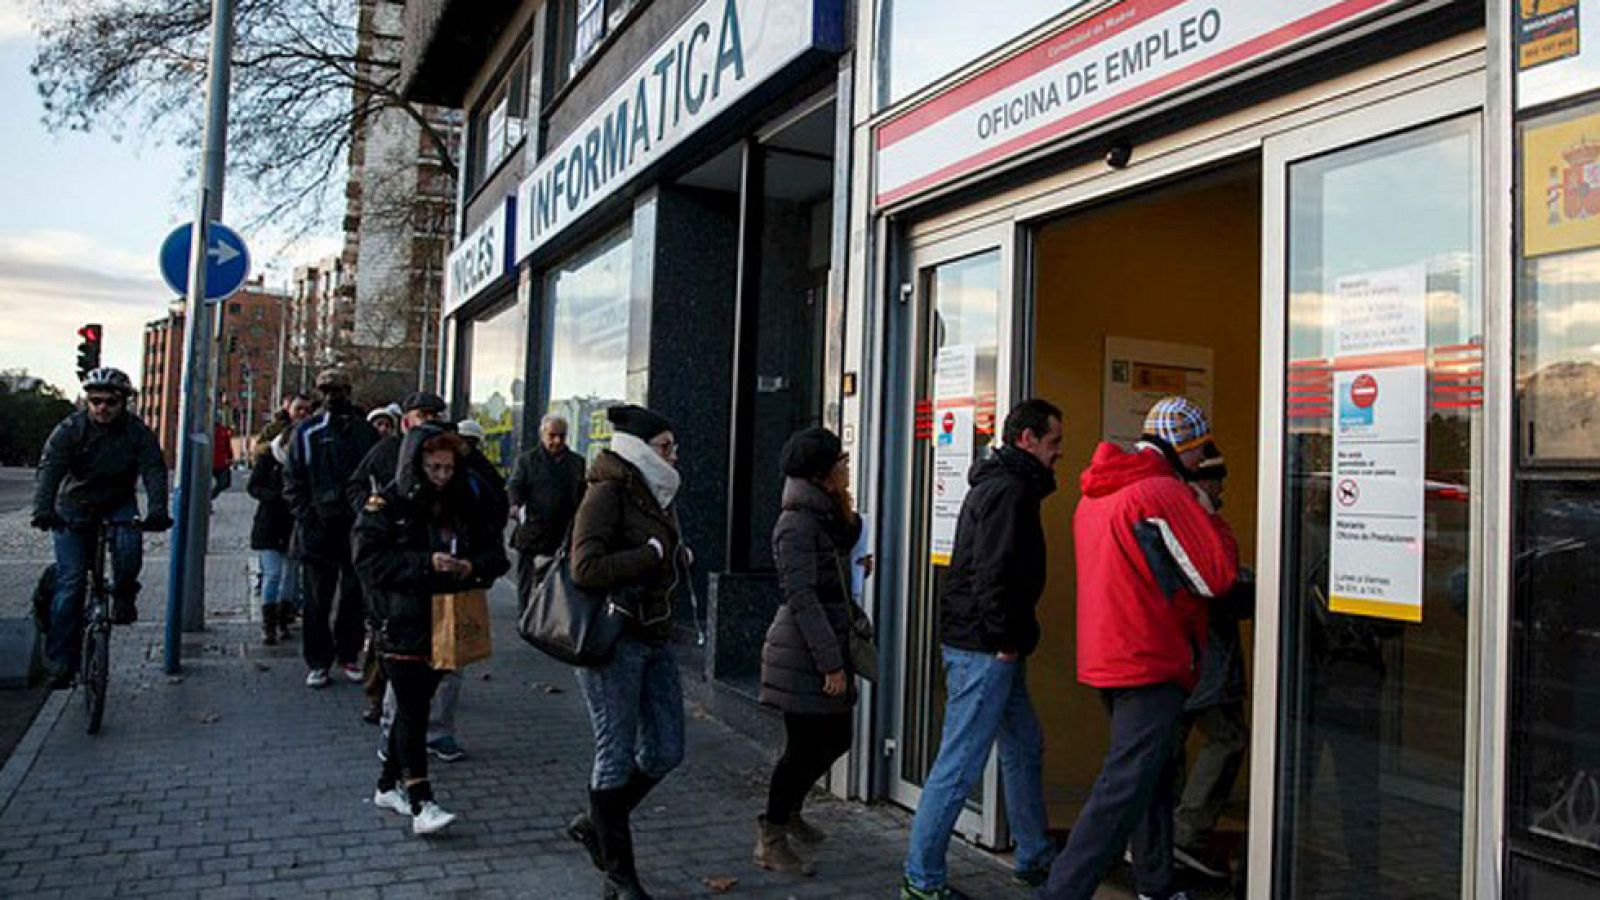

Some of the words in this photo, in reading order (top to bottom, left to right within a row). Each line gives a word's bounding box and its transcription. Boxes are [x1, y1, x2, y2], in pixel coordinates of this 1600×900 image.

[529, 0, 747, 242] INFORMATICA
[977, 81, 1061, 140] OFICINA
[1065, 62, 1098, 102] DE
[1105, 7, 1222, 86] EMPLEO
